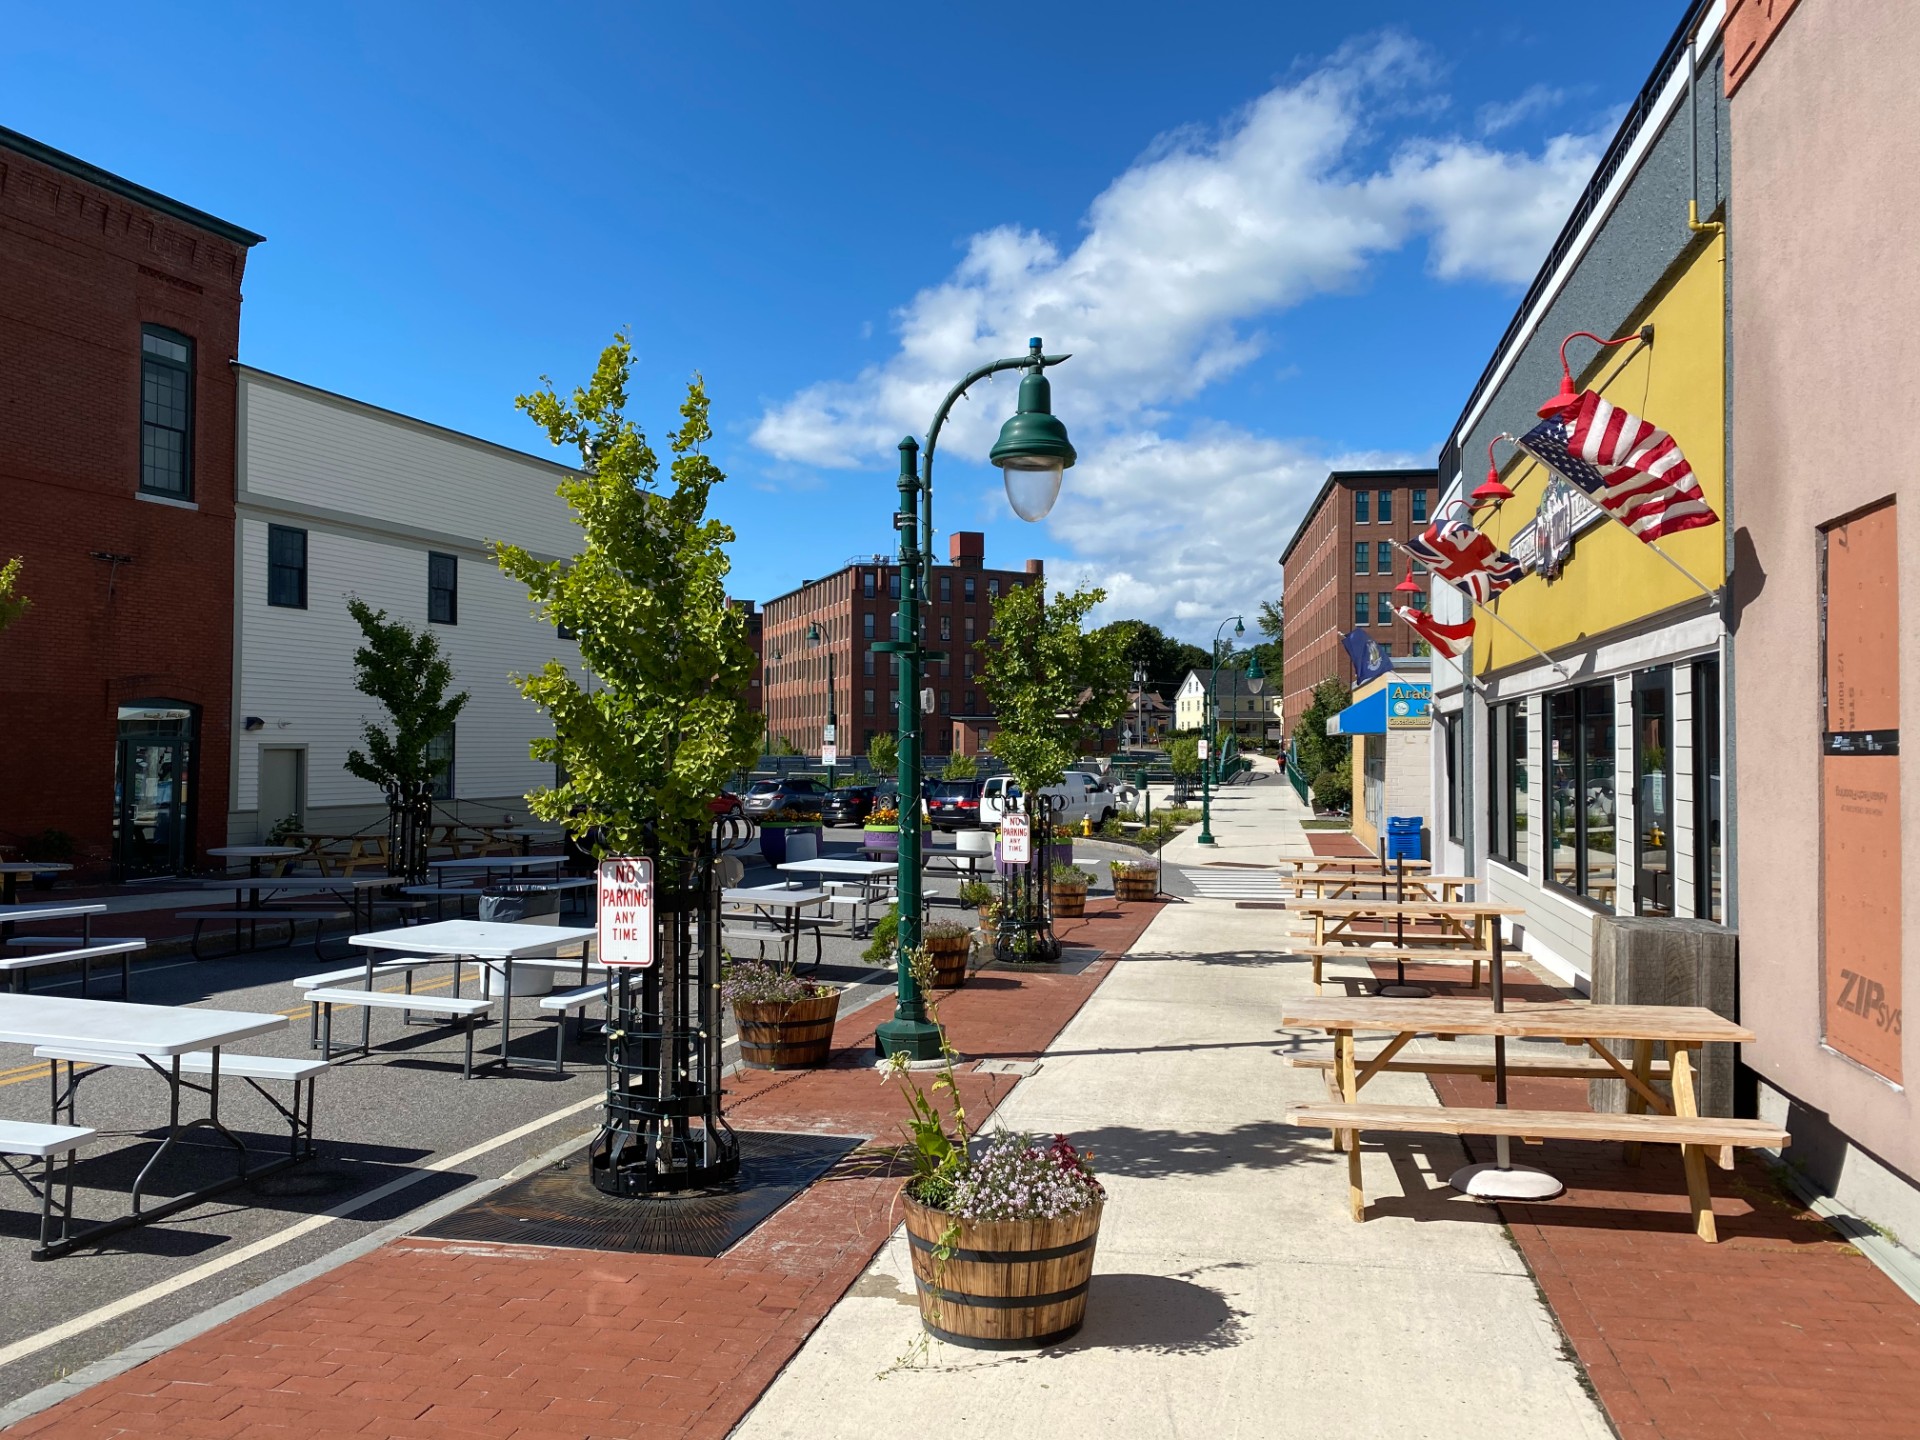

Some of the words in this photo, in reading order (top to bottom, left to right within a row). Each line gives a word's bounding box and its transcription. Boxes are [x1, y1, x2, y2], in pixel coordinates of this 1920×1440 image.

[1010, 817, 1021, 825] NO
[1004, 828, 1027, 836] PARKING
[616, 865, 635, 883] NO
[602, 888, 648, 907] PARKING
[615, 911, 635, 923] ANY
[613, 928, 637, 940] TIME
